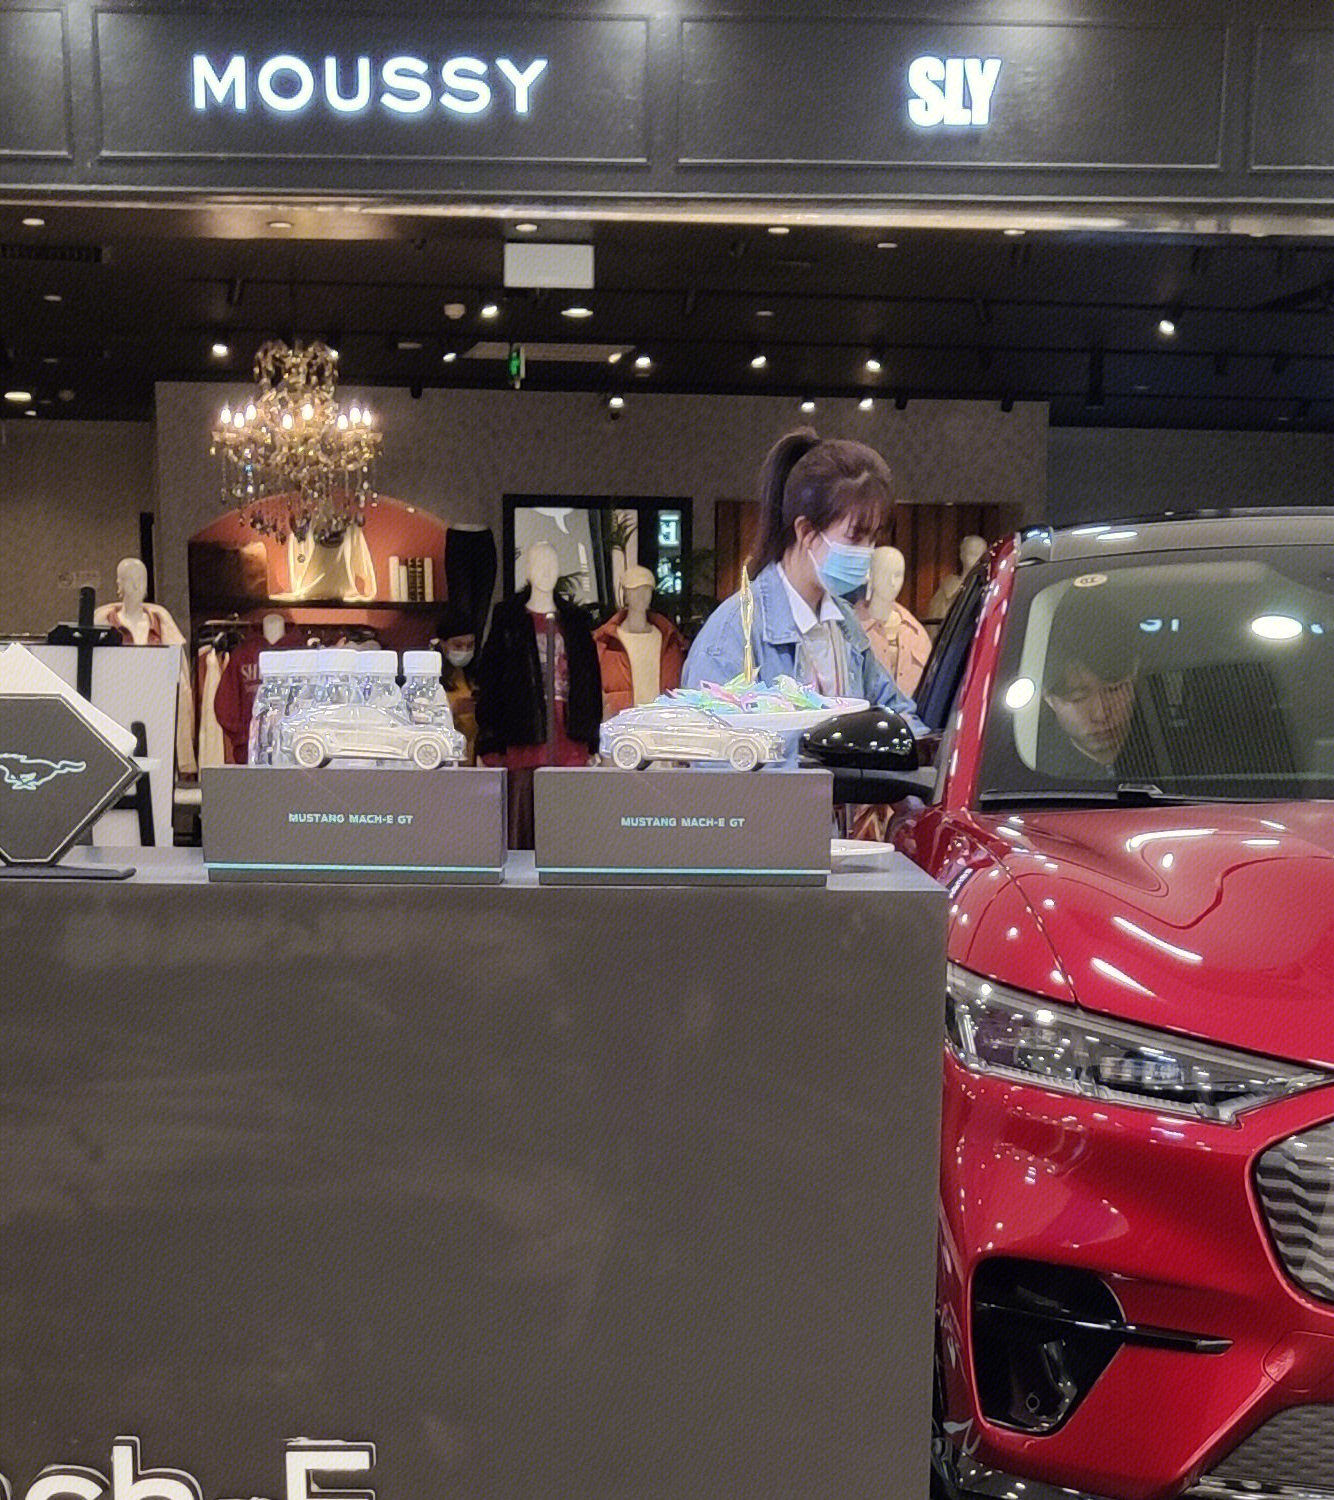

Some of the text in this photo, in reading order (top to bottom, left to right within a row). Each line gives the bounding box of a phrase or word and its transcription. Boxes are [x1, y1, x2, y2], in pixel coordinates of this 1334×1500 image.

[192, 54, 549, 114] MOUSSY
[908, 56, 1002, 127] SLY
[288, 812, 414, 825] MUSTANG MACH-E GT
[620, 816, 746, 828] MUSTANG MACH-E GT
